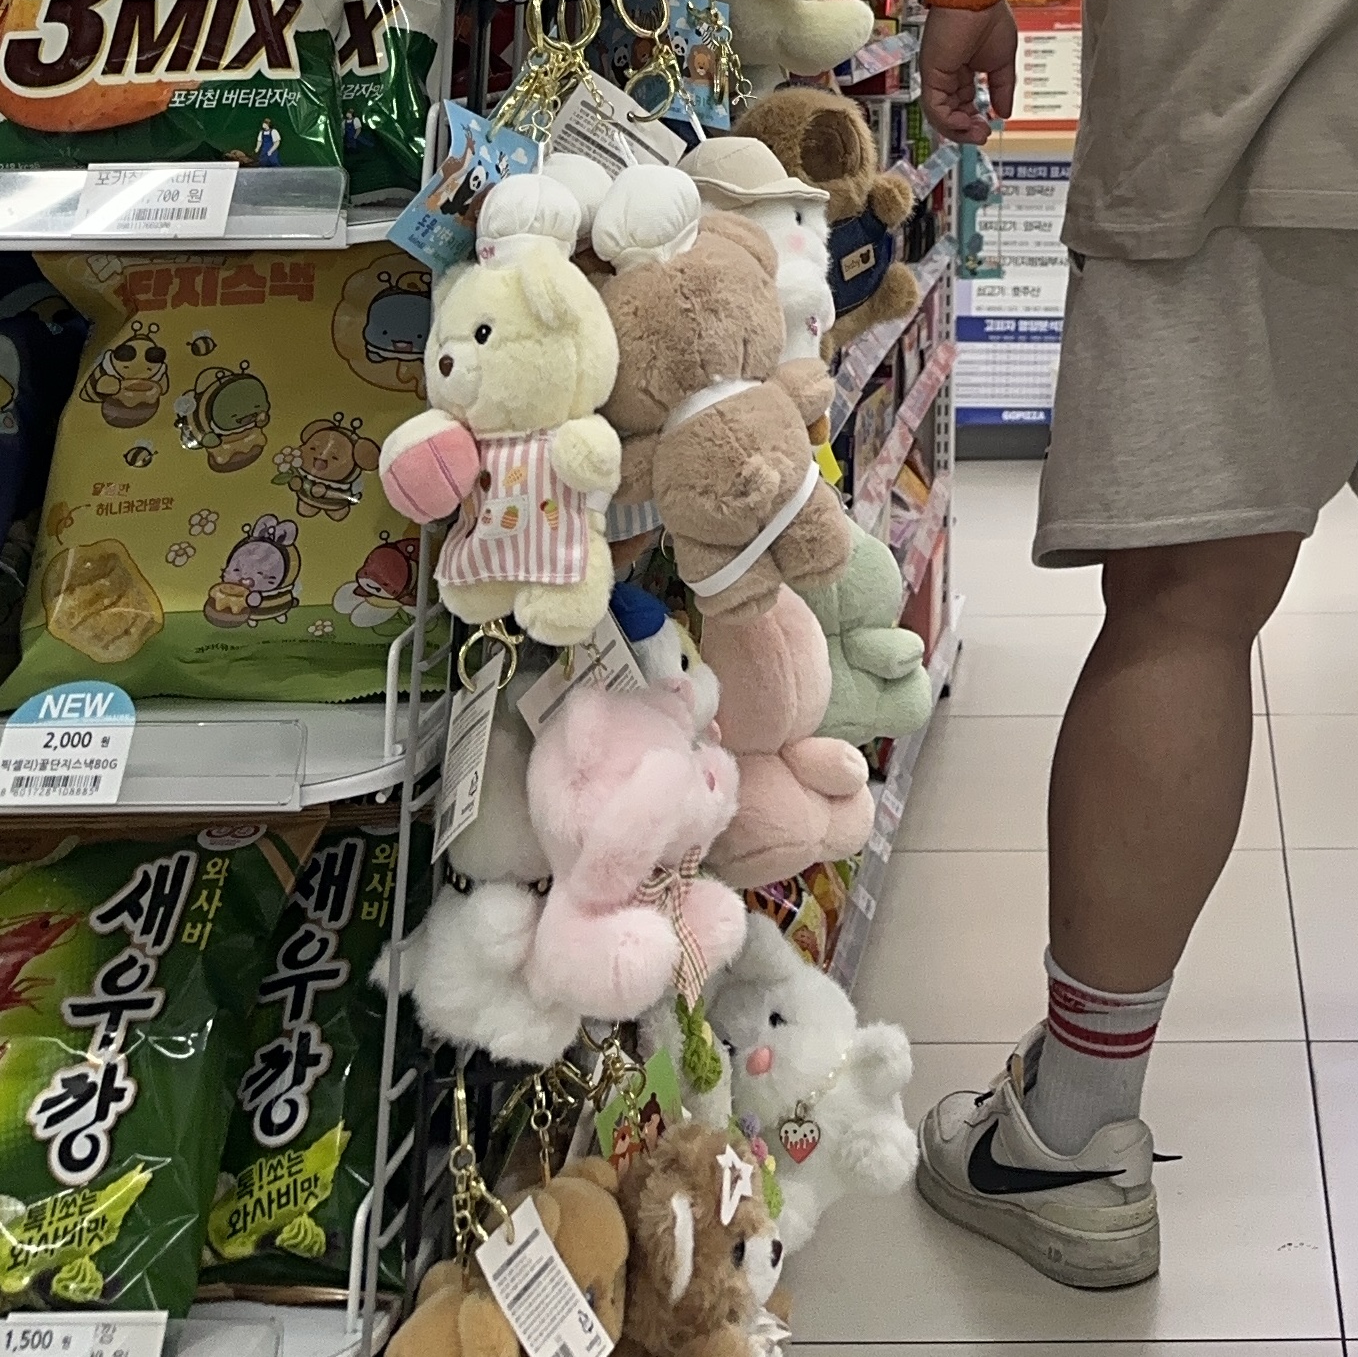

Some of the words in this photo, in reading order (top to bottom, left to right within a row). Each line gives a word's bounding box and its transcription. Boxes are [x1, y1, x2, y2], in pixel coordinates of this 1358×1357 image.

[170, 90, 224, 109] 포카칩
[222, 88, 301, 108] 버터감자맛
[187, 188, 203, 203] 원
[39, 692, 115, 719] NEW
[43, 731, 93, 752] 2,000
[183, 857, 230, 951] 와사비
[361, 842, 399, 928] 와사비
[242, 840, 357, 1140] 새우깡
[36, 854, 192, 1174] 새우깡
[226, 1174, 320, 1239] 와사비맛
[5, 1329, 53, 1353] 1,500
